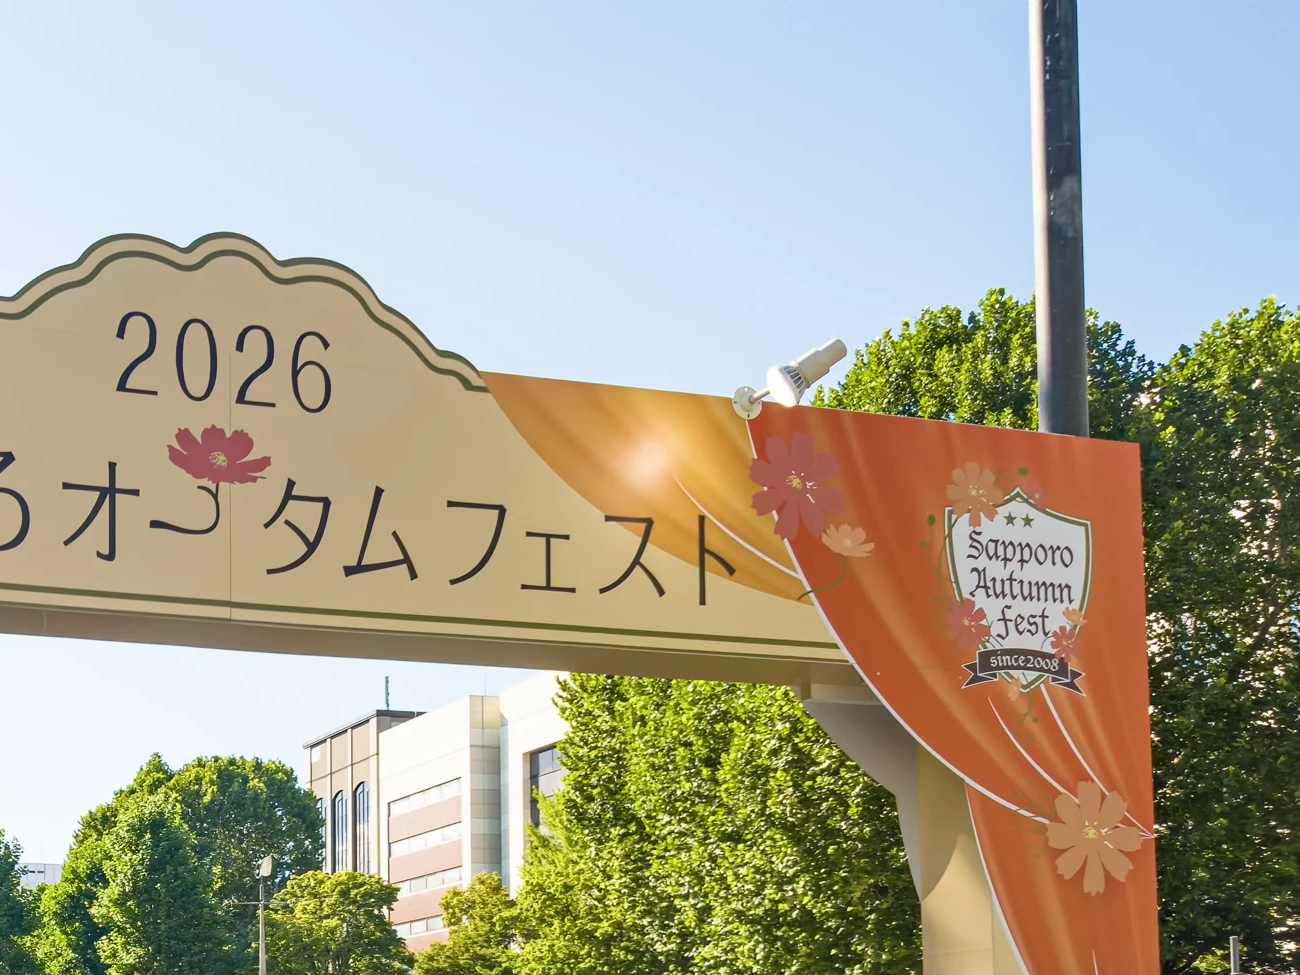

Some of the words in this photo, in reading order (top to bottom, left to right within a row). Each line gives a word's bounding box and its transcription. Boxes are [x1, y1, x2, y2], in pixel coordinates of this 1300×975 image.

[115, 311, 332, 413] 2026
[966, 529, 1074, 571] Sapporo
[969, 567, 1075, 605] Autumn
